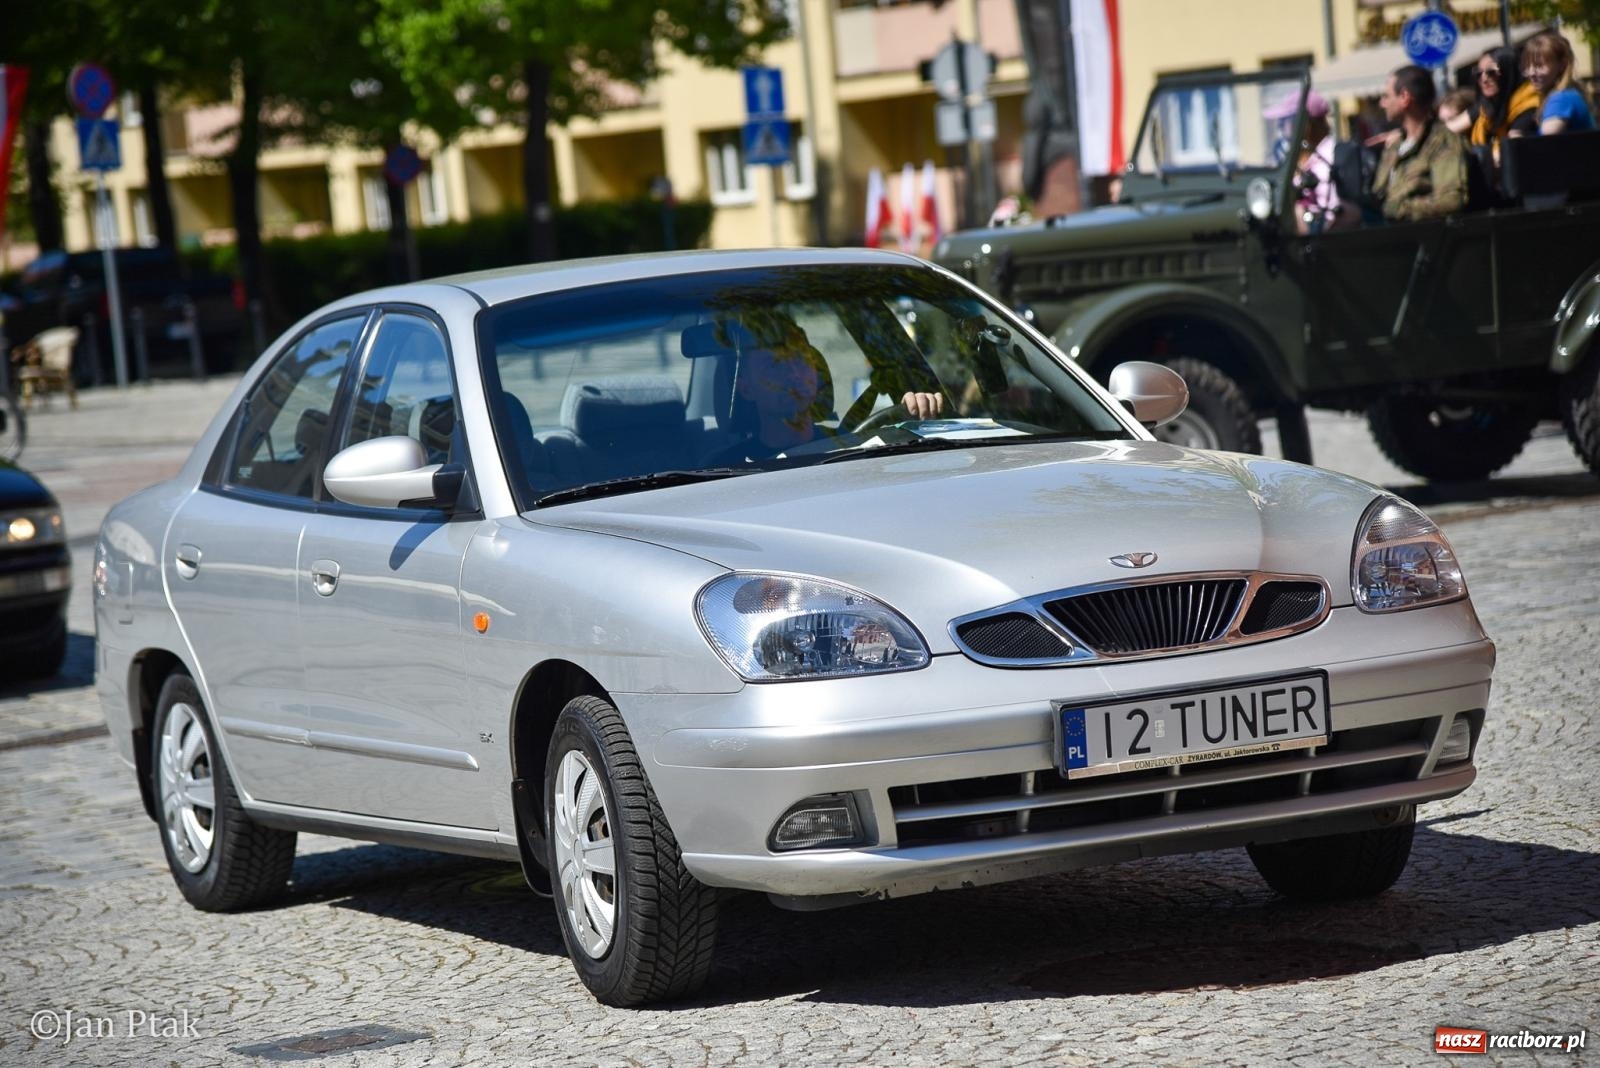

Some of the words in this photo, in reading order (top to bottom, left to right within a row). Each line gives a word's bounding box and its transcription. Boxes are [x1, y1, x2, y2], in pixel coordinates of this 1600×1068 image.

[1170, 685, 1318, 748] TUNER
[1068, 746, 1085, 760] PL
[1134, 755, 1184, 769] COMPLEX-CAR
